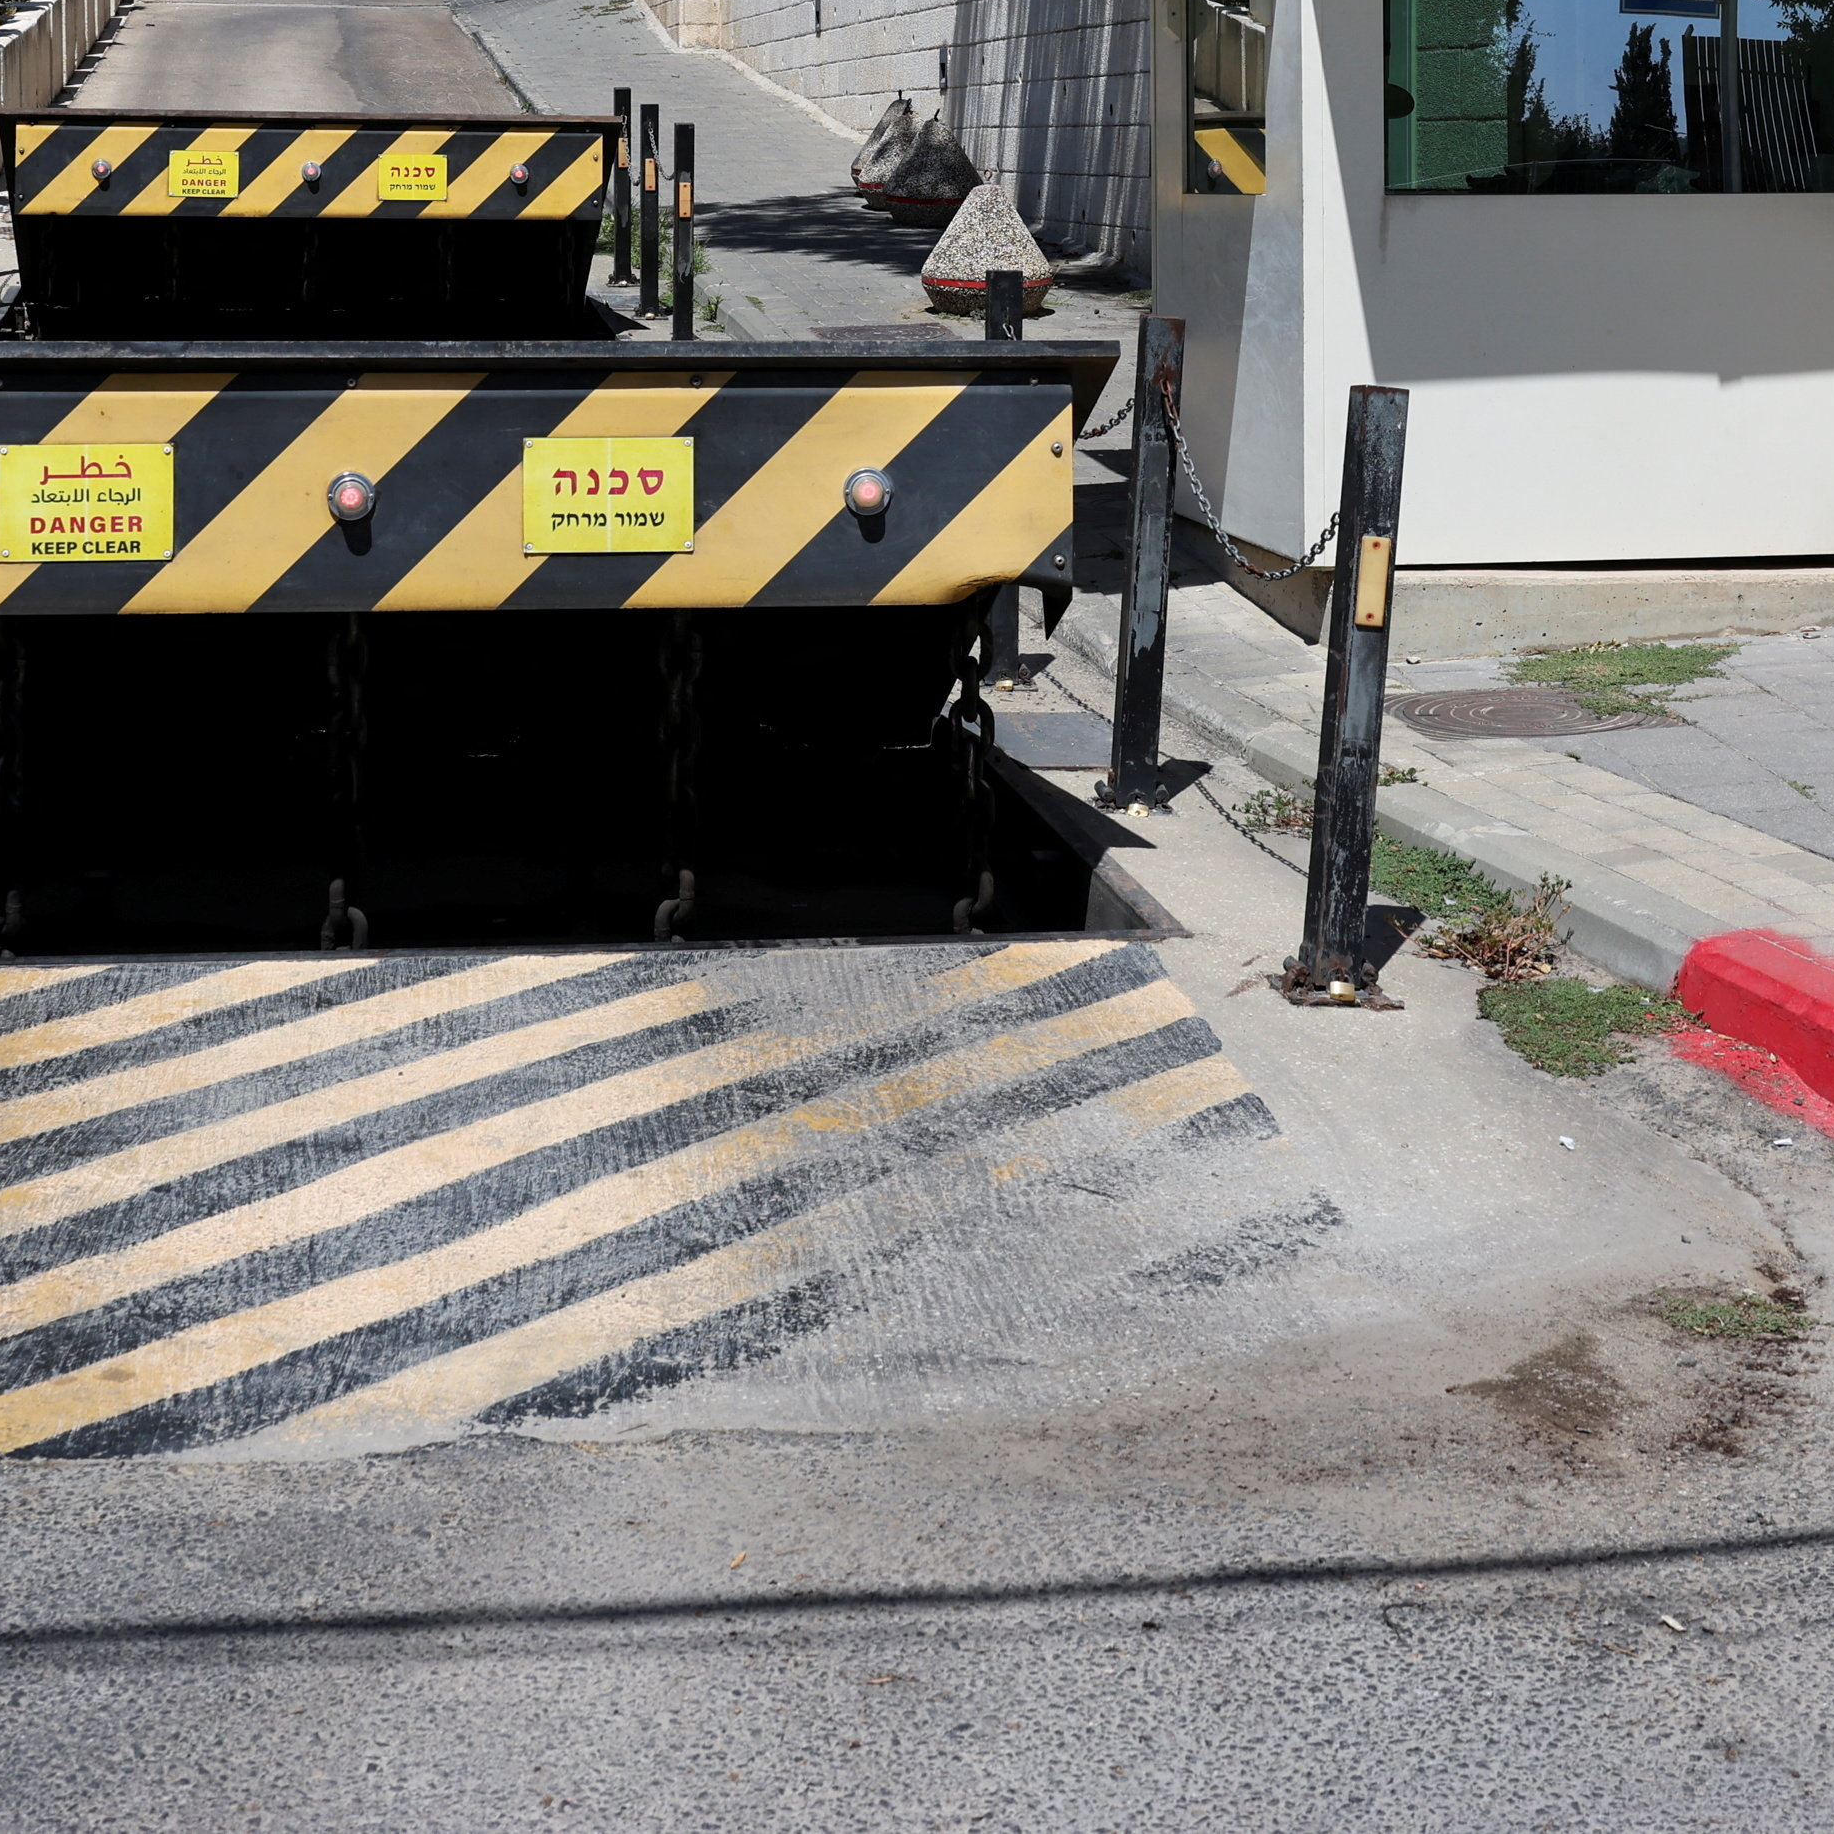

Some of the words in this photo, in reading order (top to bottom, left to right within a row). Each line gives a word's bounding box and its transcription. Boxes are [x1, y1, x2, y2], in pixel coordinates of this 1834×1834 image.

[186, 155, 223, 167] خطر
[390, 166, 435, 178] סכנה
[182, 179, 227, 187] DANGER
[389, 184, 413, 192] מרחק
[39, 454, 133, 486] خطر
[552, 466, 664, 497] סכנה
[31, 488, 90, 507] الابتعاد
[96, 487, 141, 506] الرجاء
[30, 515, 143, 535] DANGER
[551, 512, 607, 532] מרחק
[614, 511, 665, 527] שמור
[31, 541, 78, 555] KEEP
[82, 540, 142, 554] CLEAR
